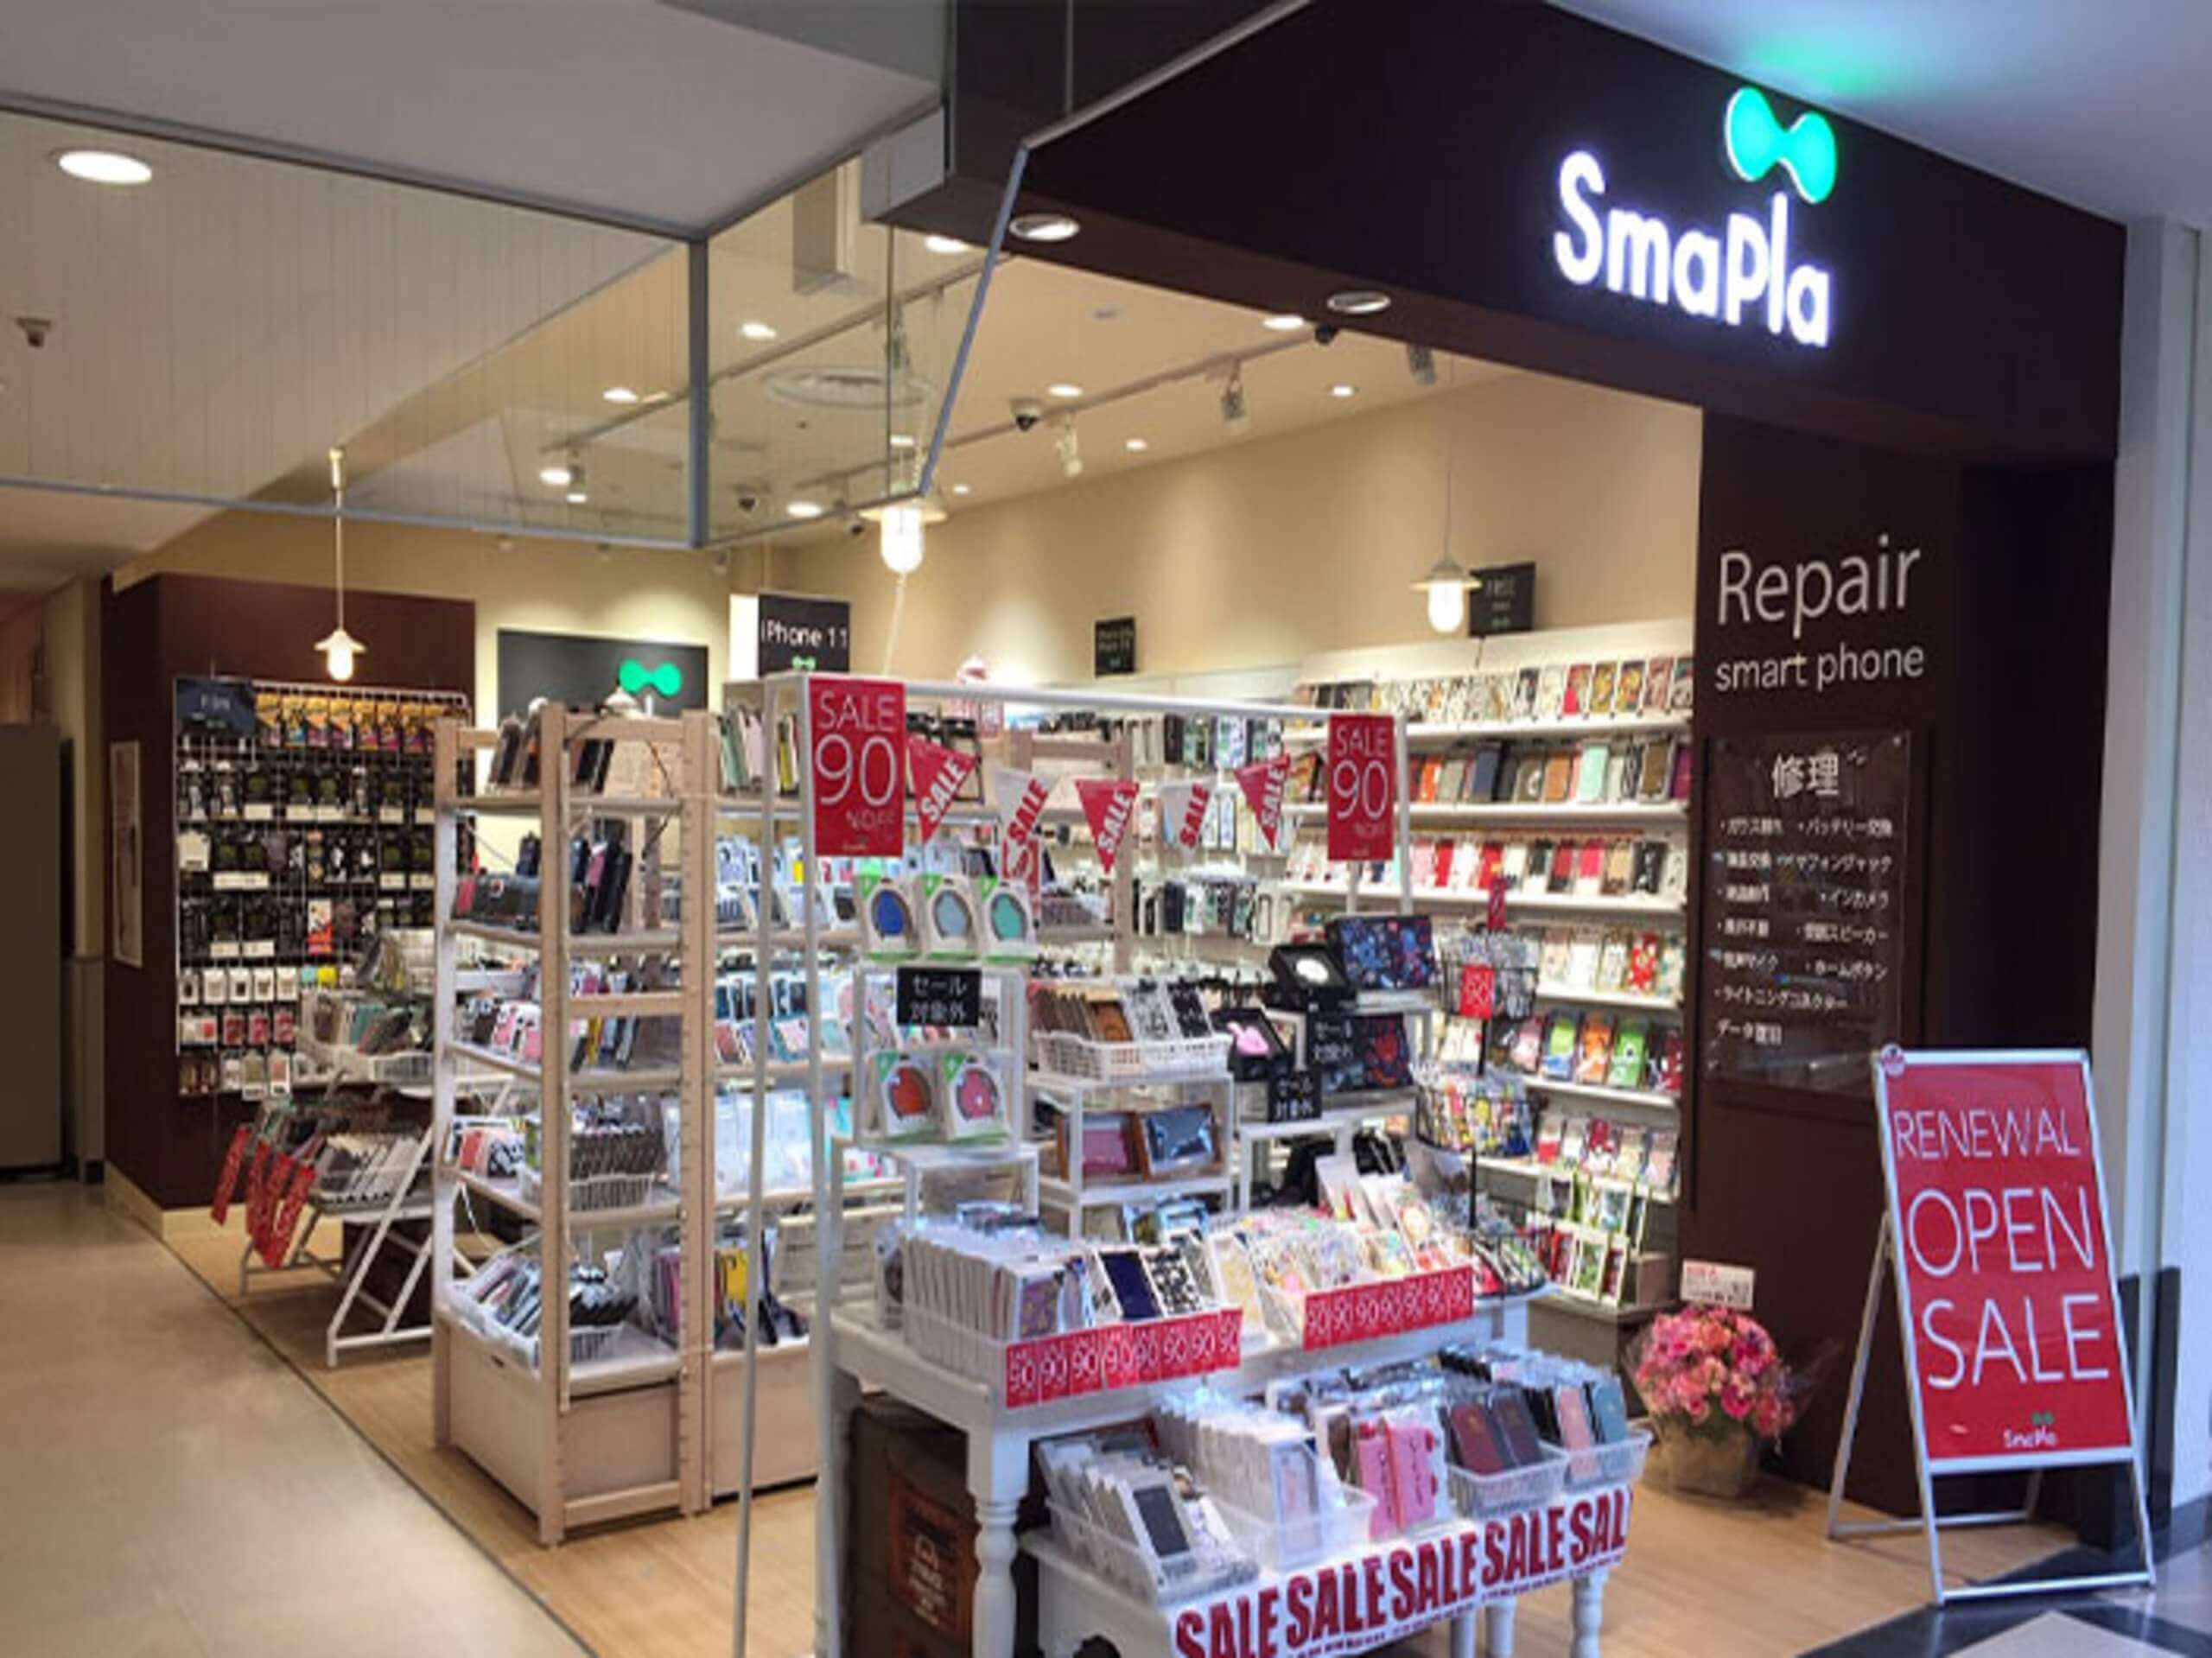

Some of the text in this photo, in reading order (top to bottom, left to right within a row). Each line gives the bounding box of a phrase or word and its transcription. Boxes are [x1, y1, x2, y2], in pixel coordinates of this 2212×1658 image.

[1554, 150, 1829, 346] SmaPla
[1717, 532, 1921, 640] Repair
[828, 626, 848, 649] 11
[1714, 642, 1924, 691] smart phone
[817, 690, 895, 733] SALE
[1337, 724, 1388, 758] SALE
[816, 734, 897, 807] 90
[920, 755, 965, 822] SALE
[1261, 762, 1287, 828] SALE
[1333, 759, 1389, 820] 90
[1771, 752, 1839, 798] 修理
[1007, 778, 1048, 846] SALE
[1097, 789, 1134, 854] SALE
[1178, 782, 1211, 849] SALE
[1893, 1108, 2081, 1160] RENEWAL
[1907, 1186, 2094, 1278] OPEN
[1921, 1293, 2109, 1389] SALE
[1176, 1586, 1279, 1658] SALE
[1286, 1553, 1386, 1648] SALE
[1389, 1530, 1477, 1629] SALE
[1481, 1504, 1565, 1587] SALE
[1569, 1485, 1632, 1565] SAL
